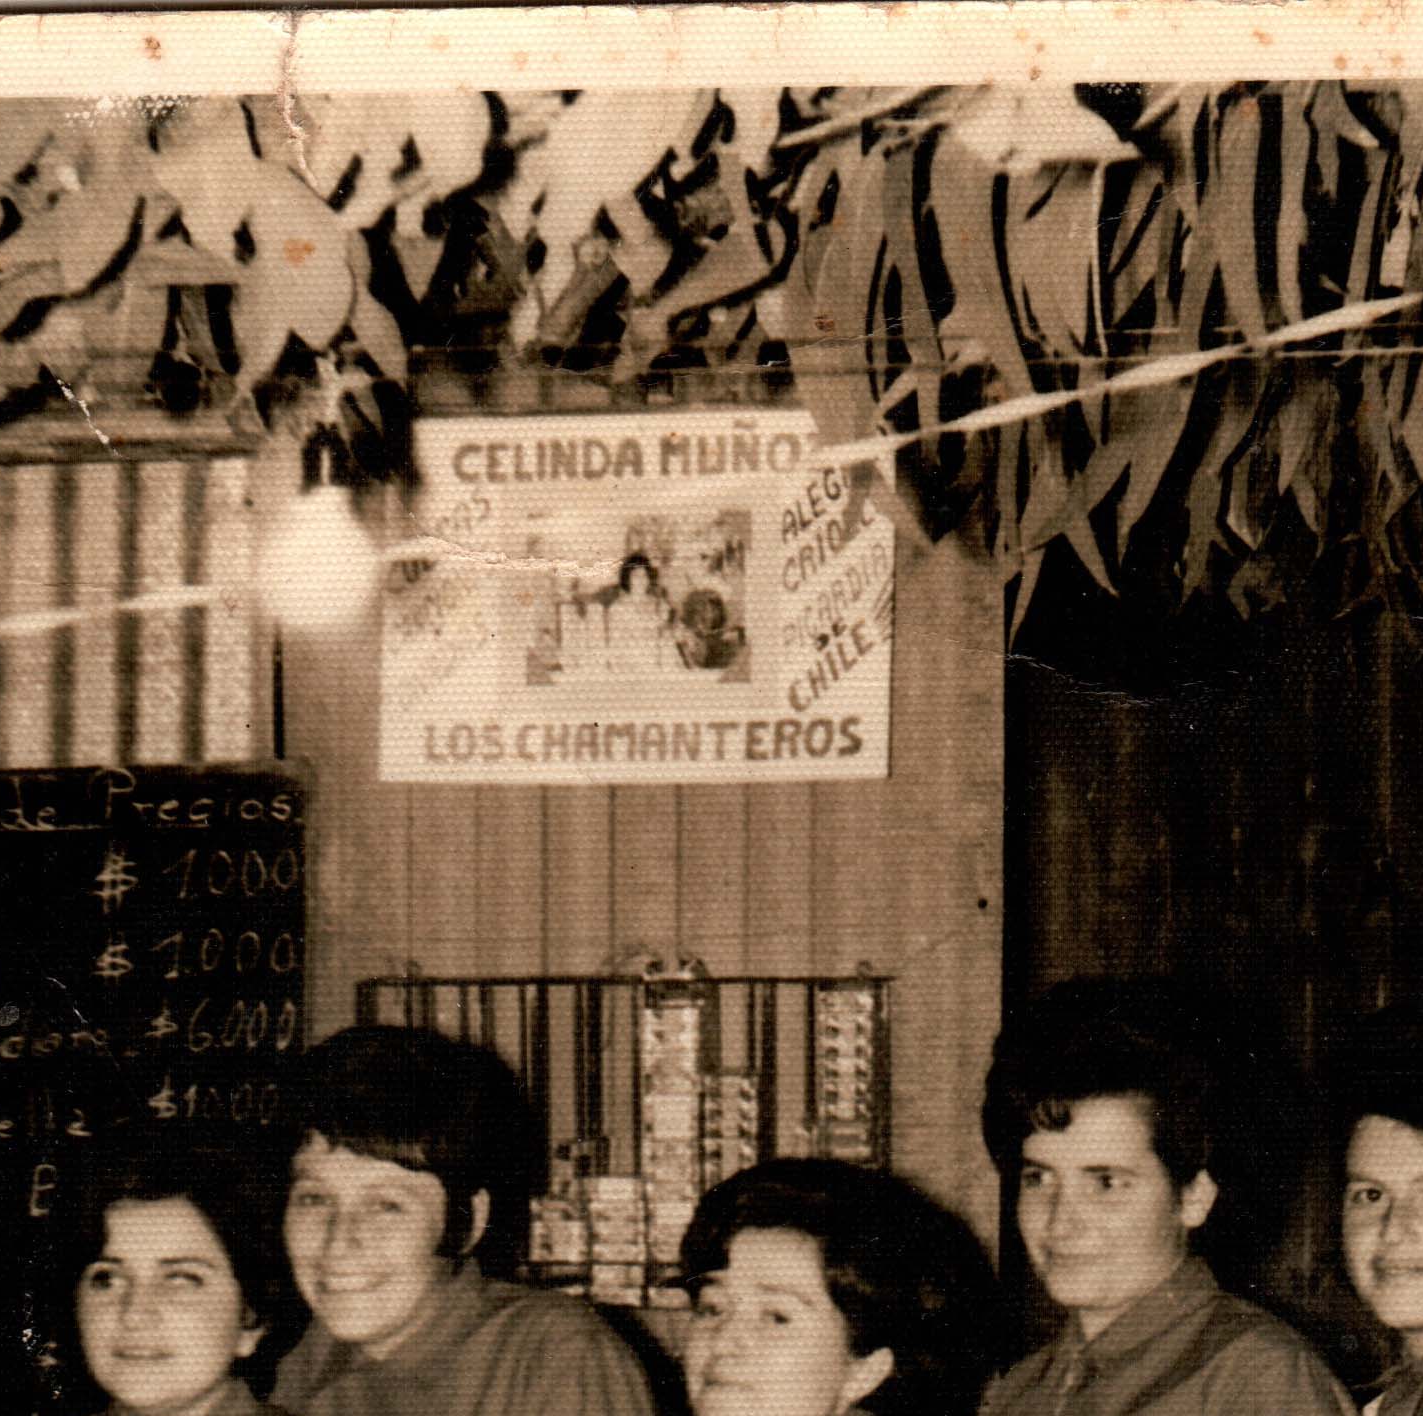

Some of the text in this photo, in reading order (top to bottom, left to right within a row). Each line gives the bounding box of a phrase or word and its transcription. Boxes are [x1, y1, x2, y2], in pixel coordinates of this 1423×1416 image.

[452, 422, 811, 485] CELINDA MUÑO
[788, 620, 875, 713] CHILE
[422, 716, 864, 765] LOS CHAMANTEROS
[1, 776, 63, 832] de
